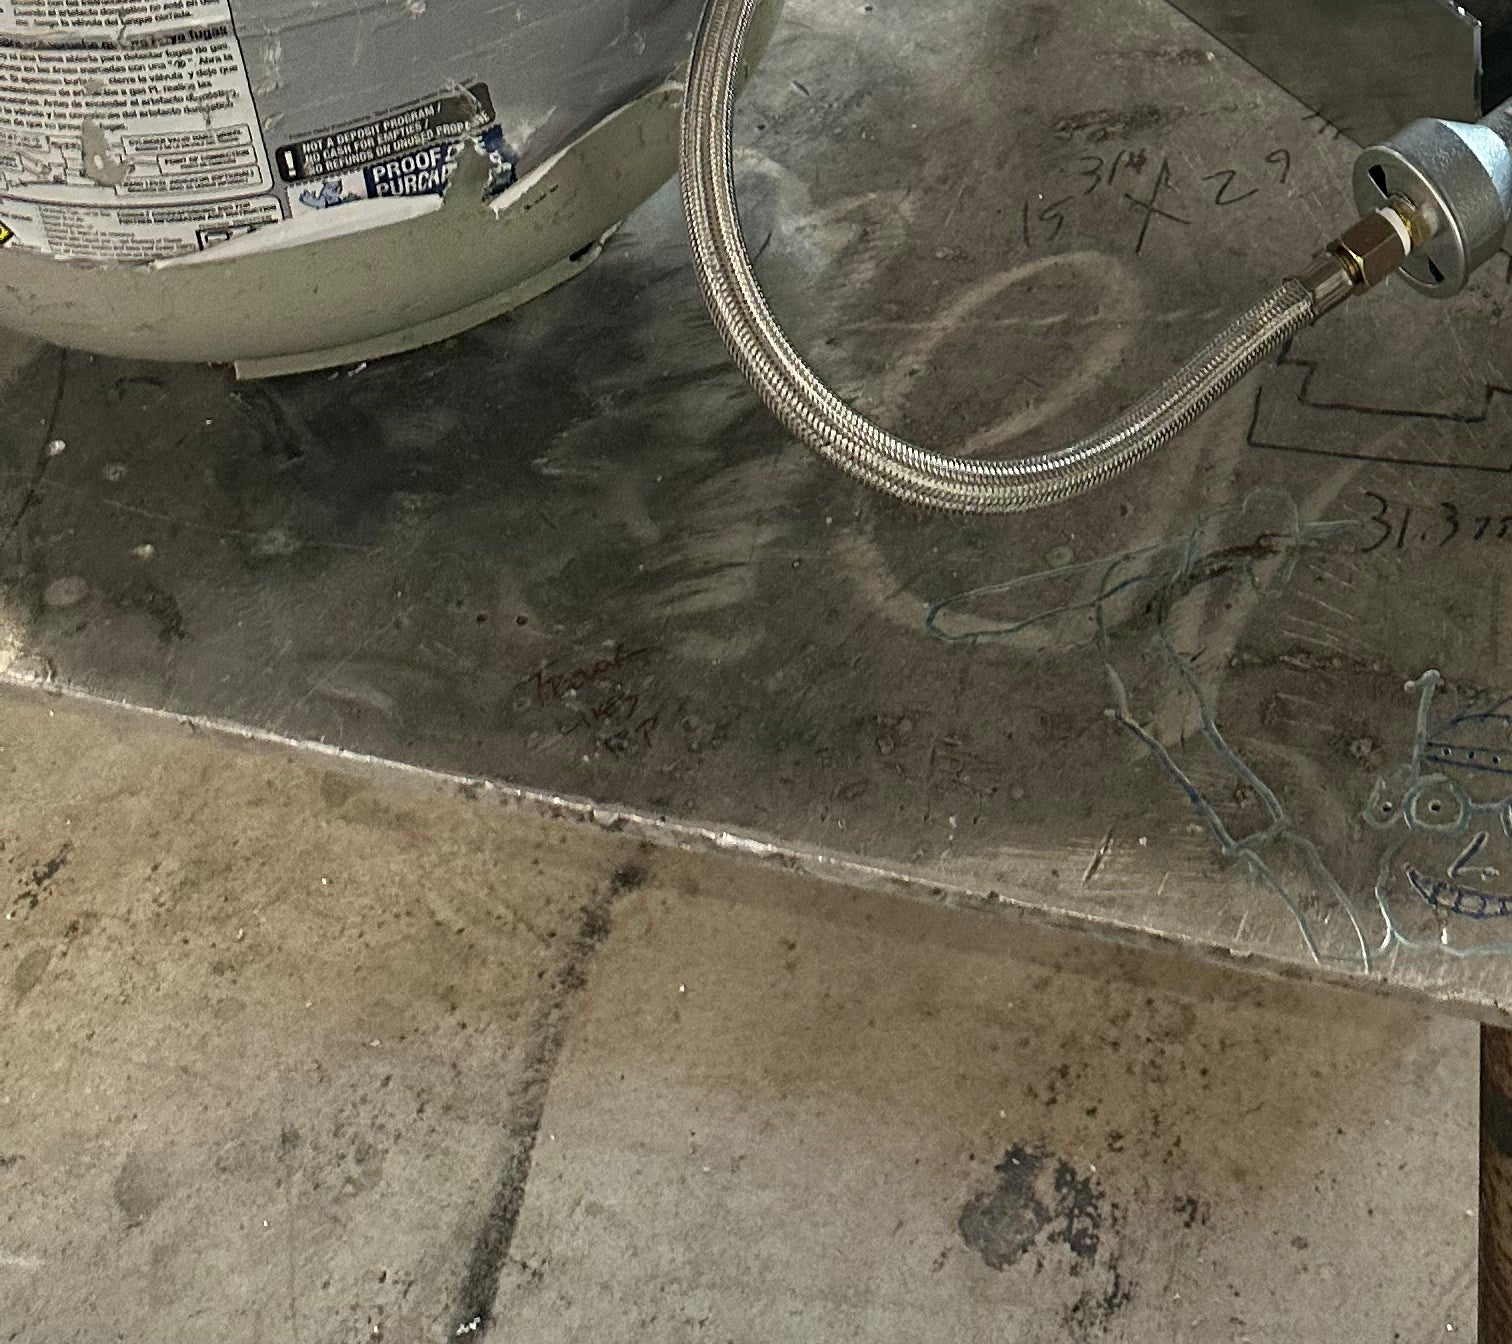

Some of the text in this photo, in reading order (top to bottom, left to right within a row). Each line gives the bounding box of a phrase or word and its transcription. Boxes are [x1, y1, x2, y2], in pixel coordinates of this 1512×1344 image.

[302, 141, 323, 154] NOT
[327, 137, 335, 148] A
[337, 124, 381, 145] DEPOSIT
[383, 104, 435, 131] PROGRAM
[304, 151, 320, 164] NO
[323, 144, 352, 160] CASH
[354, 137, 375, 152] FOR
[377, 122, 423, 147] EMPTIES
[325, 151, 374, 172] REFUNDS
[376, 146, 391, 157] ON
[393, 131, 434, 151] UNUSED
[372, 147, 442, 185] PROOF
